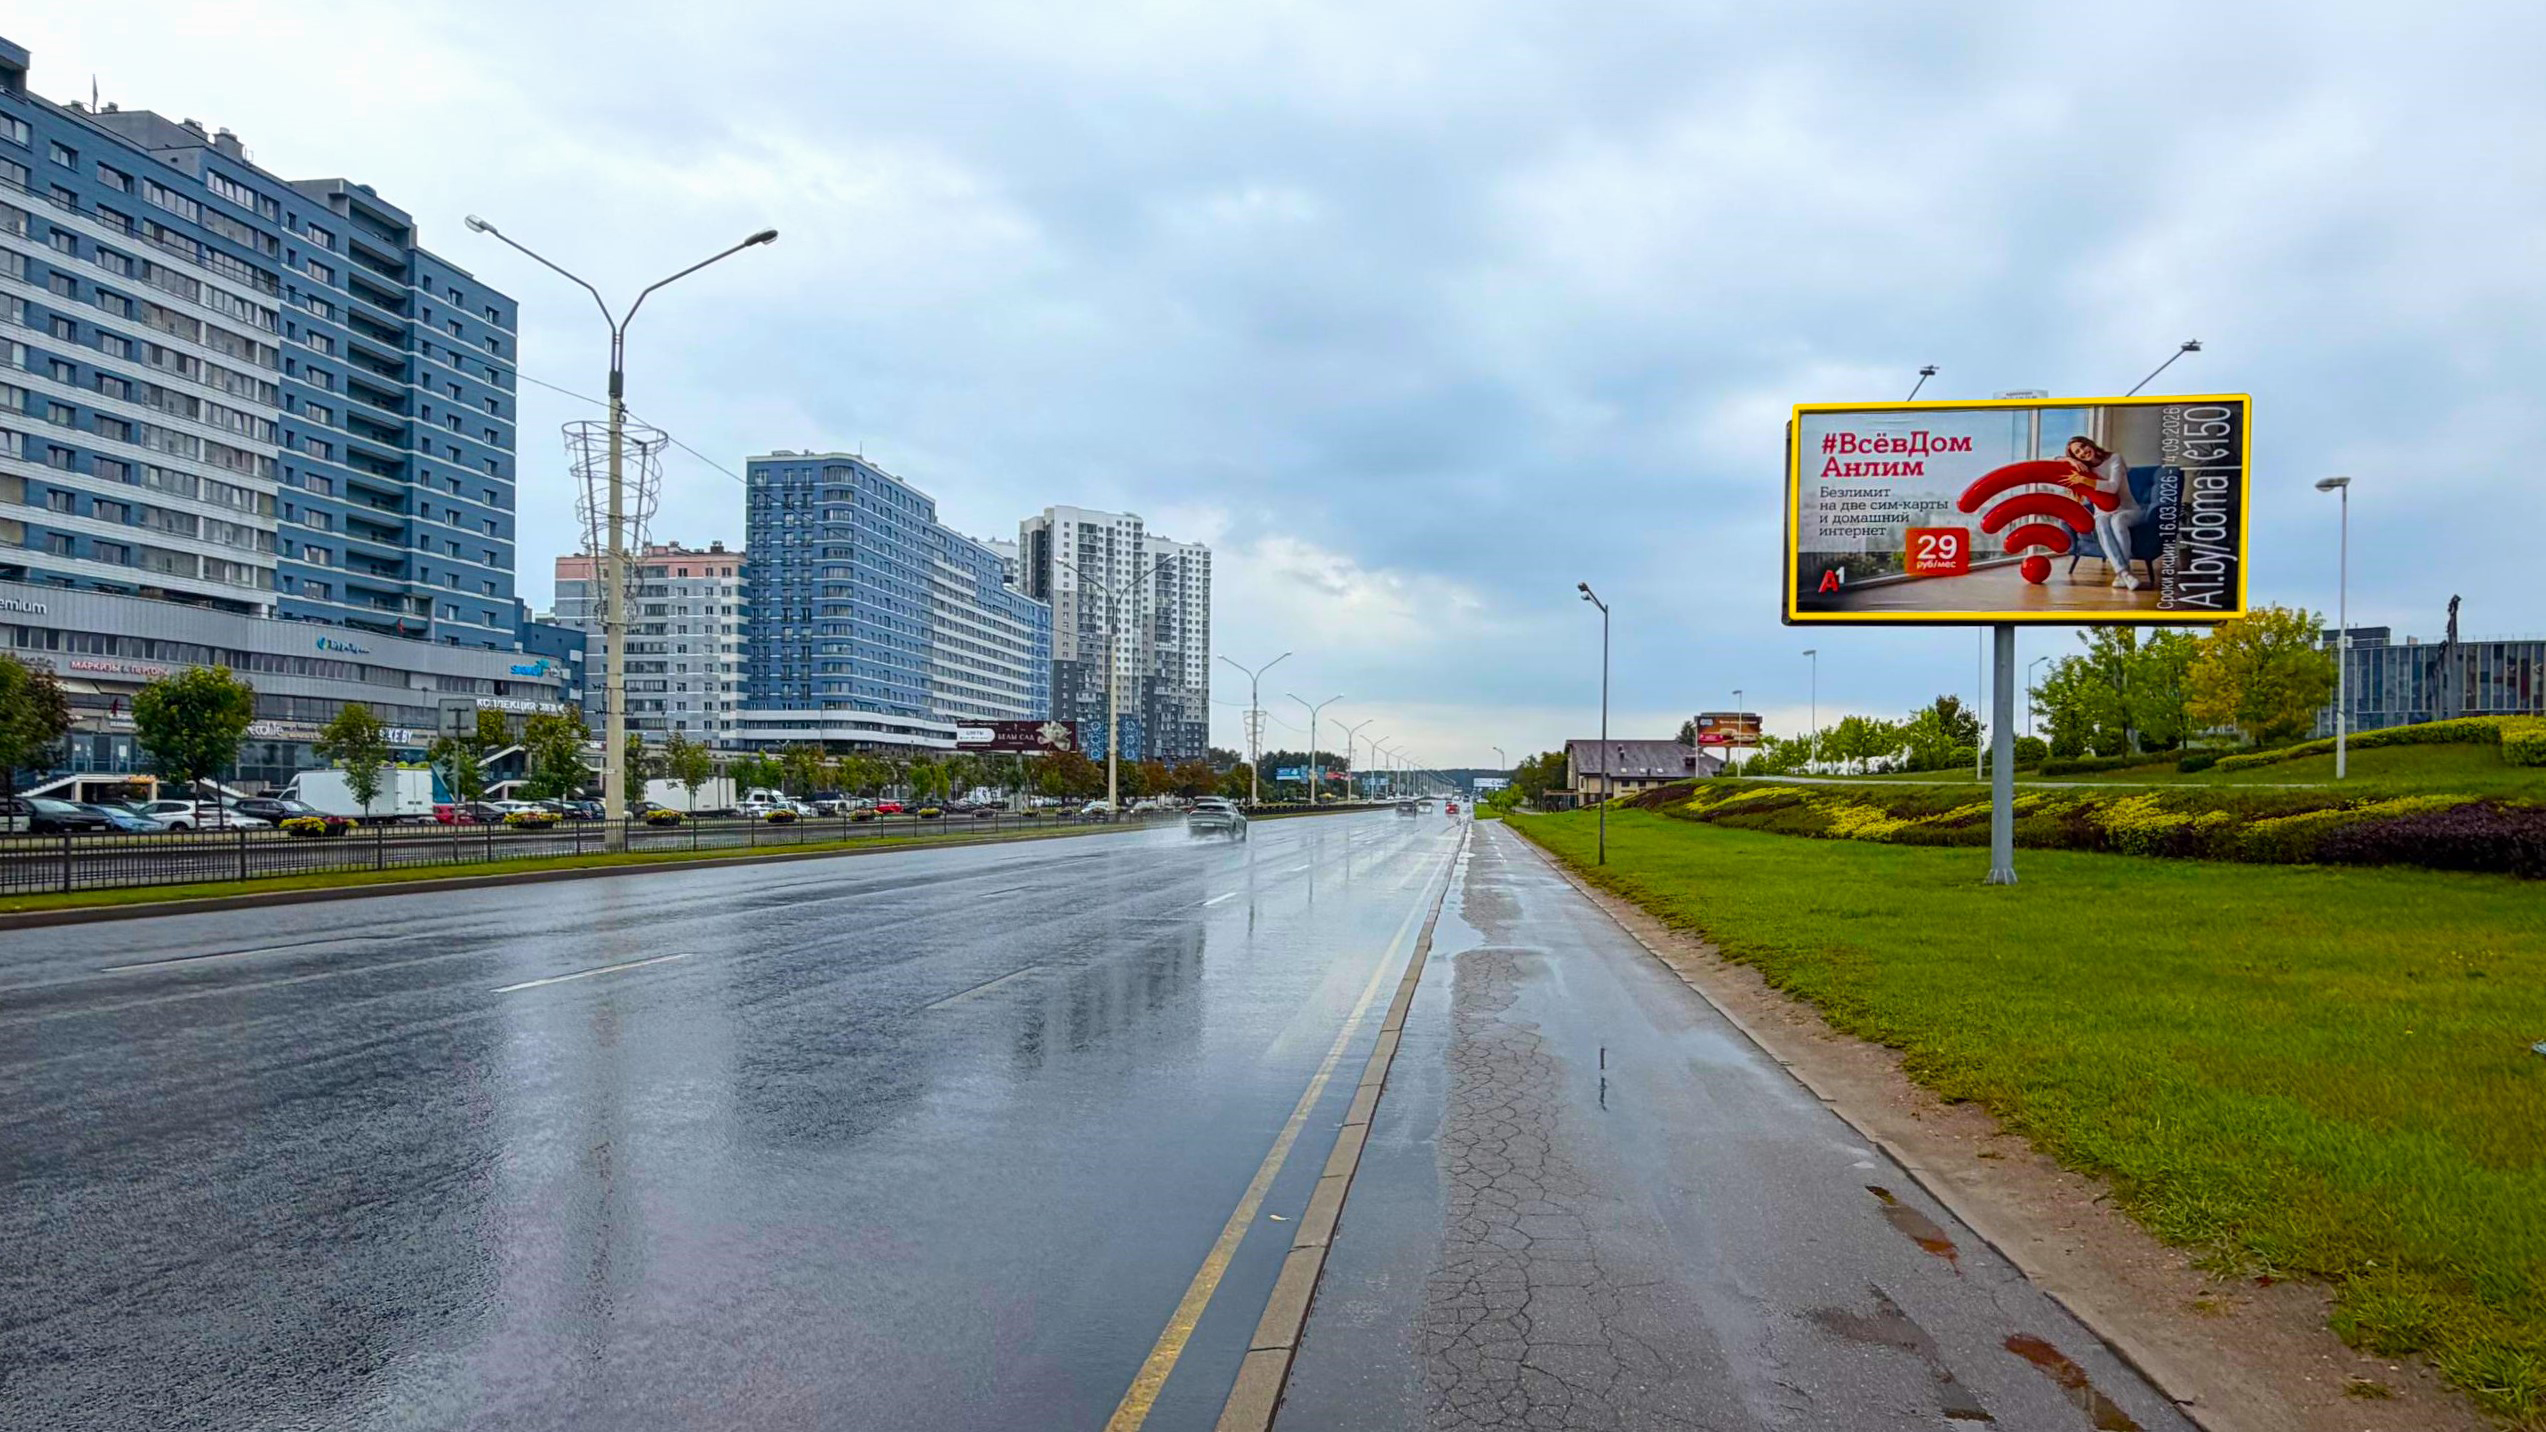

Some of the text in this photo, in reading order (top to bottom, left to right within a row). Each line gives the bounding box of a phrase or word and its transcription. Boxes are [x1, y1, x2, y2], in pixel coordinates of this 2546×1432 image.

[1821, 430, 1973, 457] #ВсёвДом
[2162, 407, 2180, 468] 14.09.2026
[1821, 456, 1924, 478] Анлим
[1819, 486, 1891, 498] Безлимит
[1819, 500, 1948, 513] на две сим-карты
[1819, 512, 1910, 525] и домашний
[2159, 475, 2178, 537] 16.03.2026
[1819, 526, 1887, 538] интернет
[2177, 475, 2238, 608] A1.by/doma
[1917, 534, 1957, 560] 29
[2161, 539, 2178, 575] акции:
[1916, 560, 1956, 570] руб/мес
[1818, 566, 1845, 593] A1
[2157, 577, 2177, 609] Сроки
